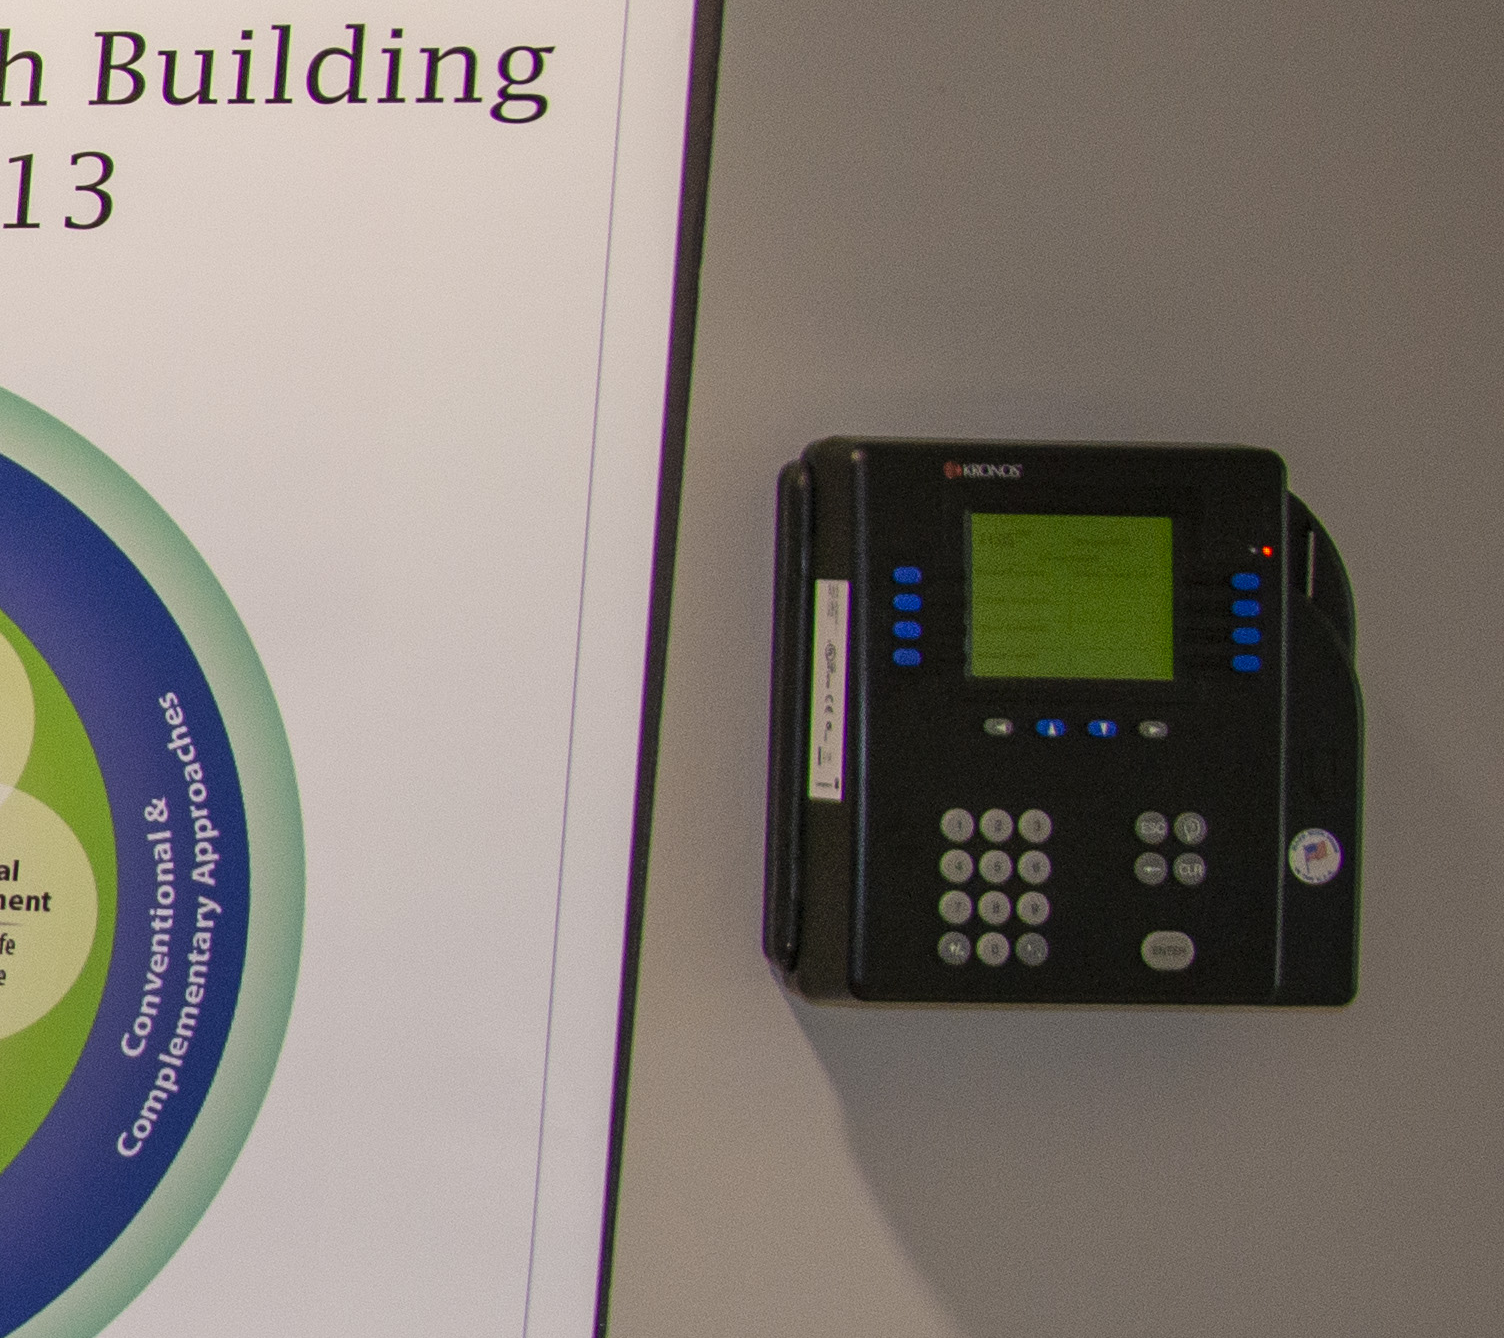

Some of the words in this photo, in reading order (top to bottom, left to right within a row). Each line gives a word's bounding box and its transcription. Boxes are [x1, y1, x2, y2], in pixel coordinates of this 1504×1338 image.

[88, 24, 556, 124] Building
[963, 464, 1021, 478] KRONOS
[144, 797, 169, 822] &
[159, 691, 221, 886] Approaches
[121, 831, 176, 1058] Conventional
[116, 894, 222, 1158] Complementary
